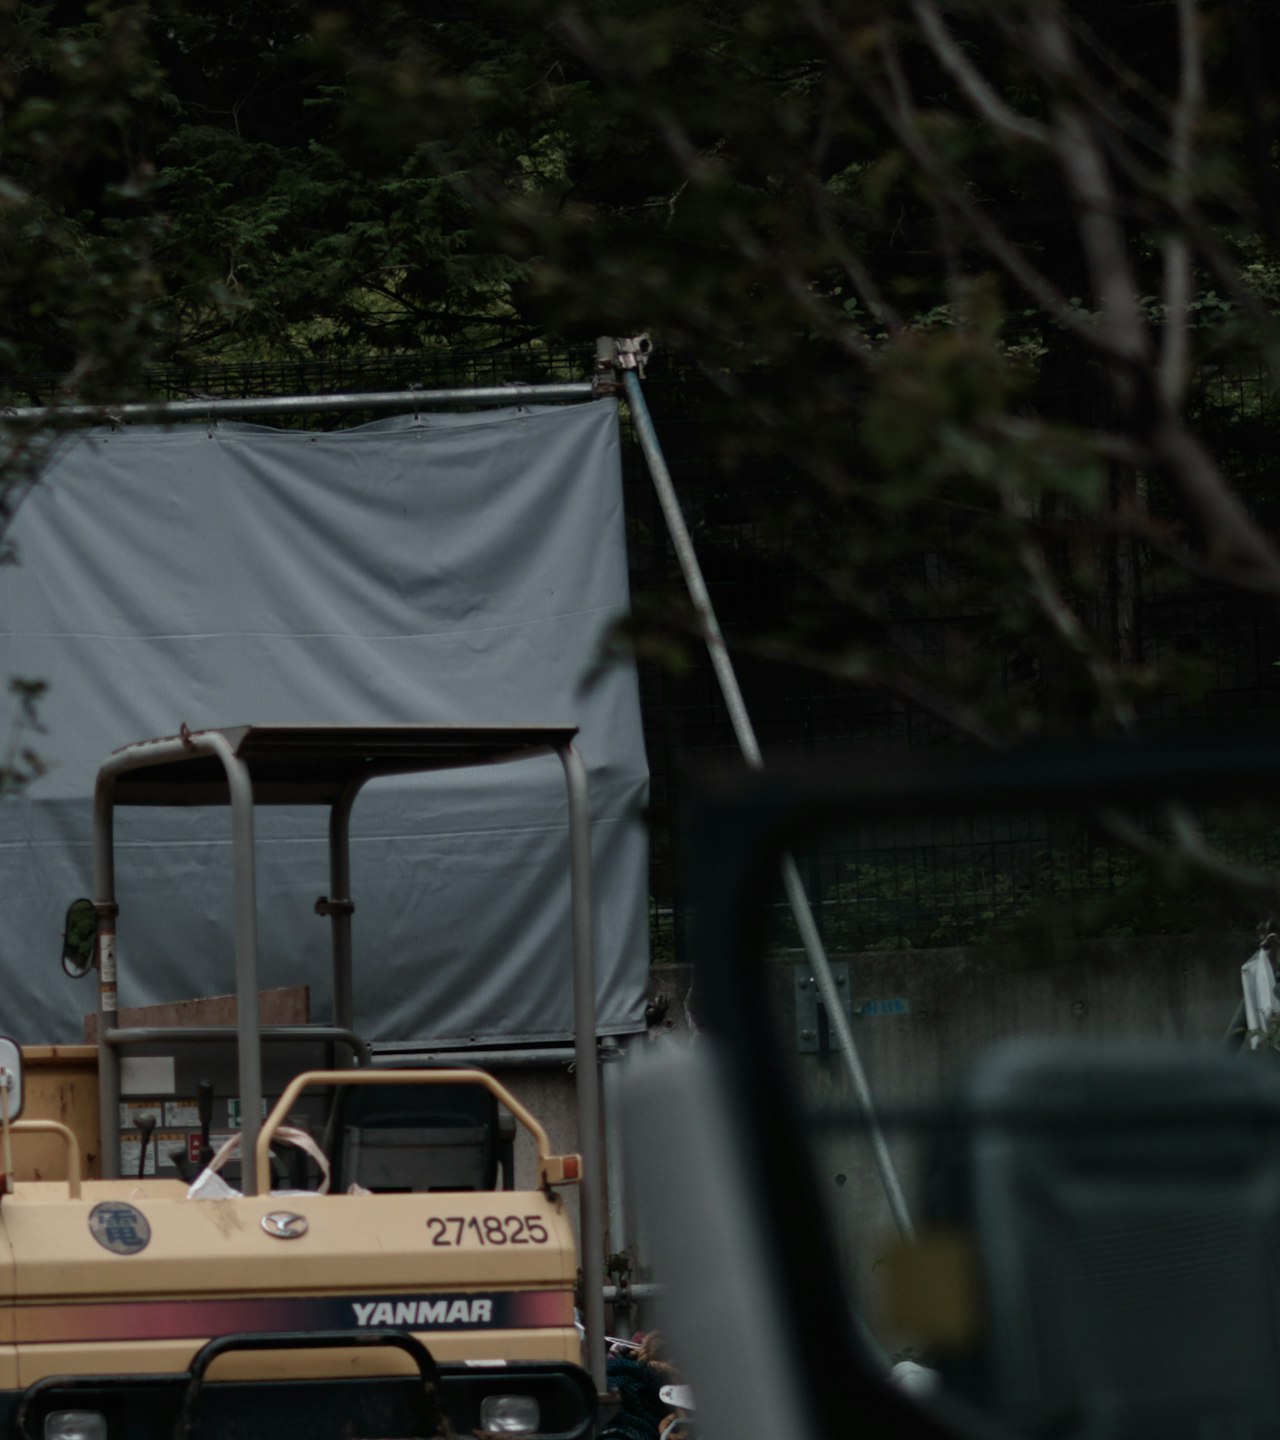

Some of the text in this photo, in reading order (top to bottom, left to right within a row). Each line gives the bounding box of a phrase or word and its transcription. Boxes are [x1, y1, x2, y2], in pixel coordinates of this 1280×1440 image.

[97, 1208, 144, 1247] 電
[426, 1214, 549, 1247] 271825
[351, 1297, 494, 1328] YANMAR
